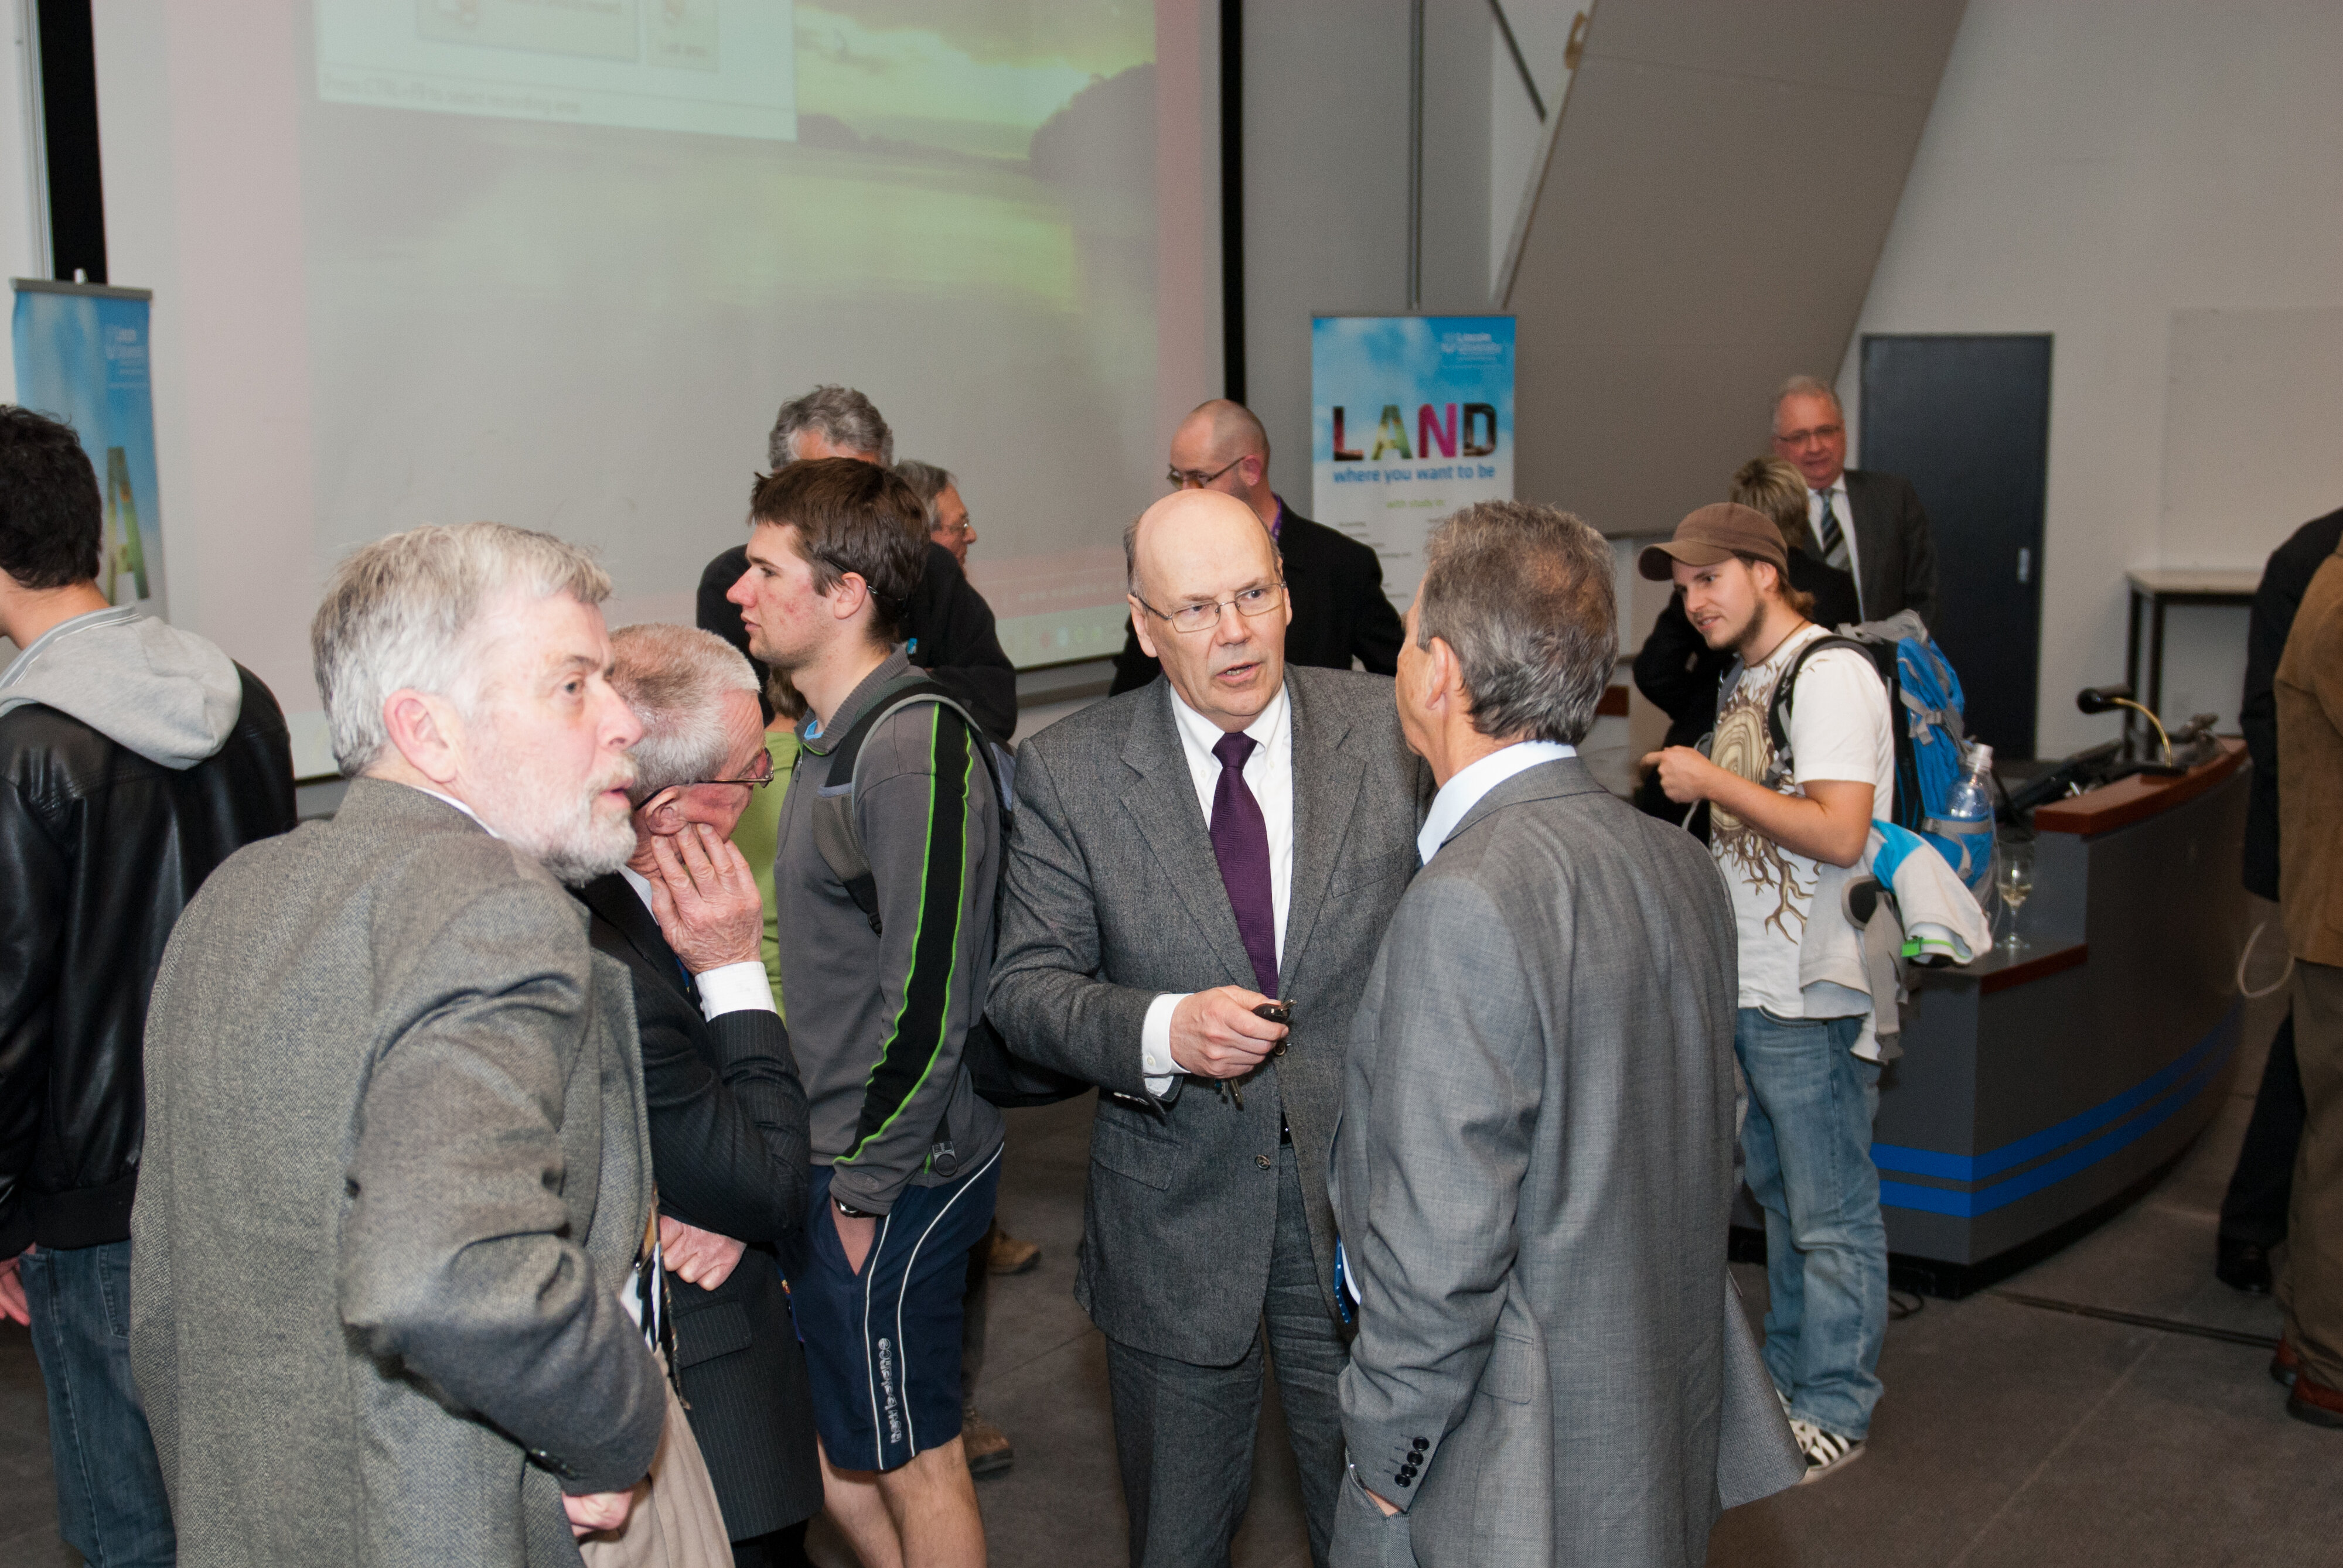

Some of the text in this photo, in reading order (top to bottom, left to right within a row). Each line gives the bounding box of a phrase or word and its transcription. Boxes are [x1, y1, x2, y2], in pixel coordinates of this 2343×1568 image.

[1333, 403, 1497, 460] LAND
[1333, 463, 1495, 484] where you want to be
[879, 1338, 902, 1443] new balance
